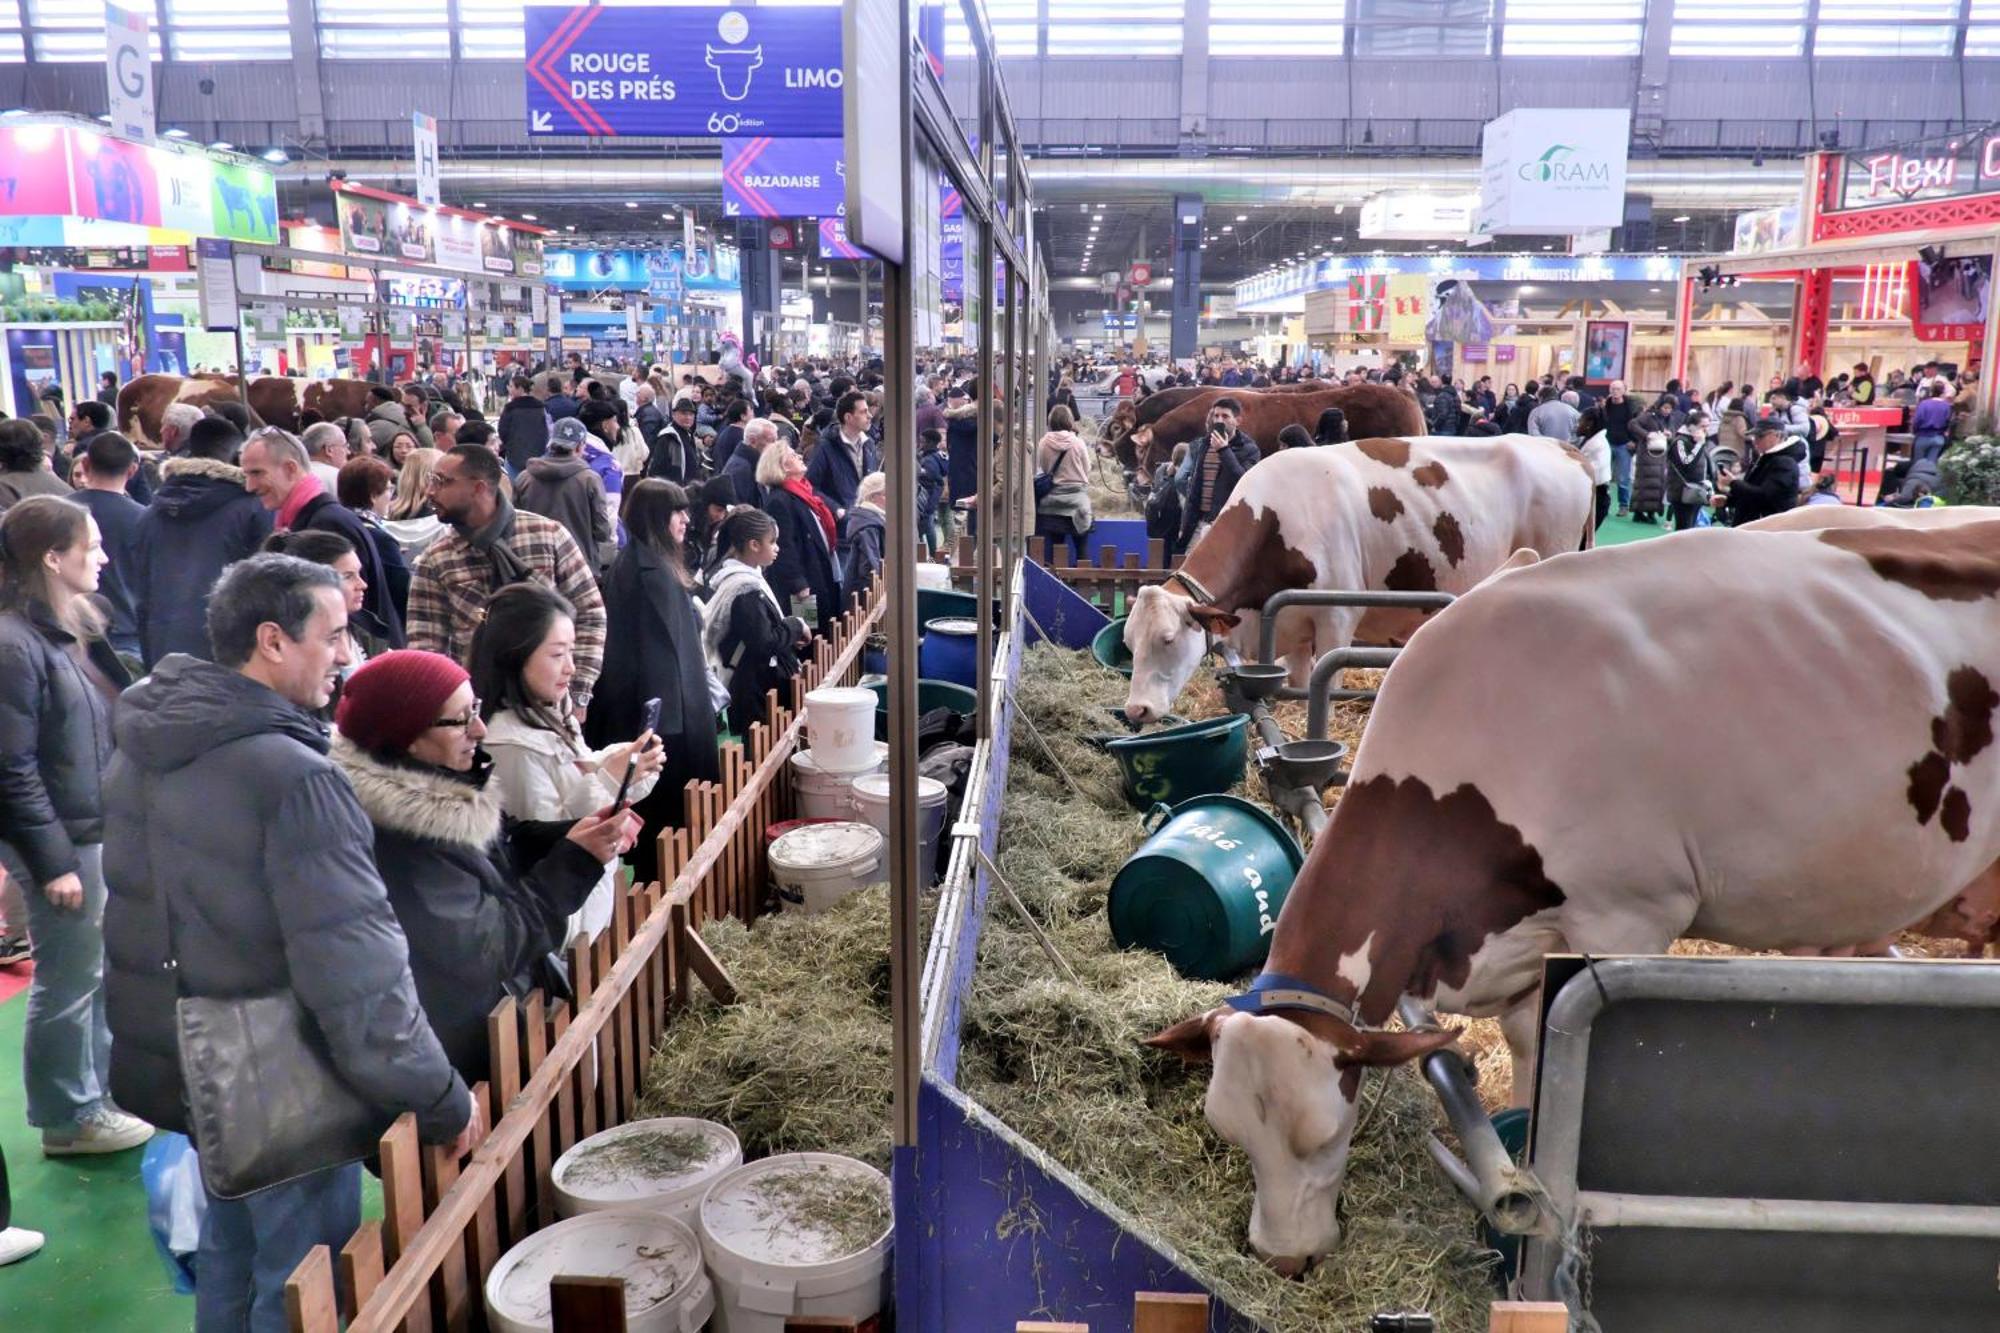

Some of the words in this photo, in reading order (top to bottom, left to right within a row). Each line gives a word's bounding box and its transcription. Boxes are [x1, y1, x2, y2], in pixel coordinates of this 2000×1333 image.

[116, 44, 145, 98] G
[570, 53, 650, 72] ROUGE
[571, 80, 614, 100] DES
[619, 75, 676, 100] PRÉS
[785, 68, 843, 88] LIMO
[420, 139, 434, 178] H
[1868, 142, 1955, 197] Flexi
[744, 176, 820, 188] BAZADAISE
